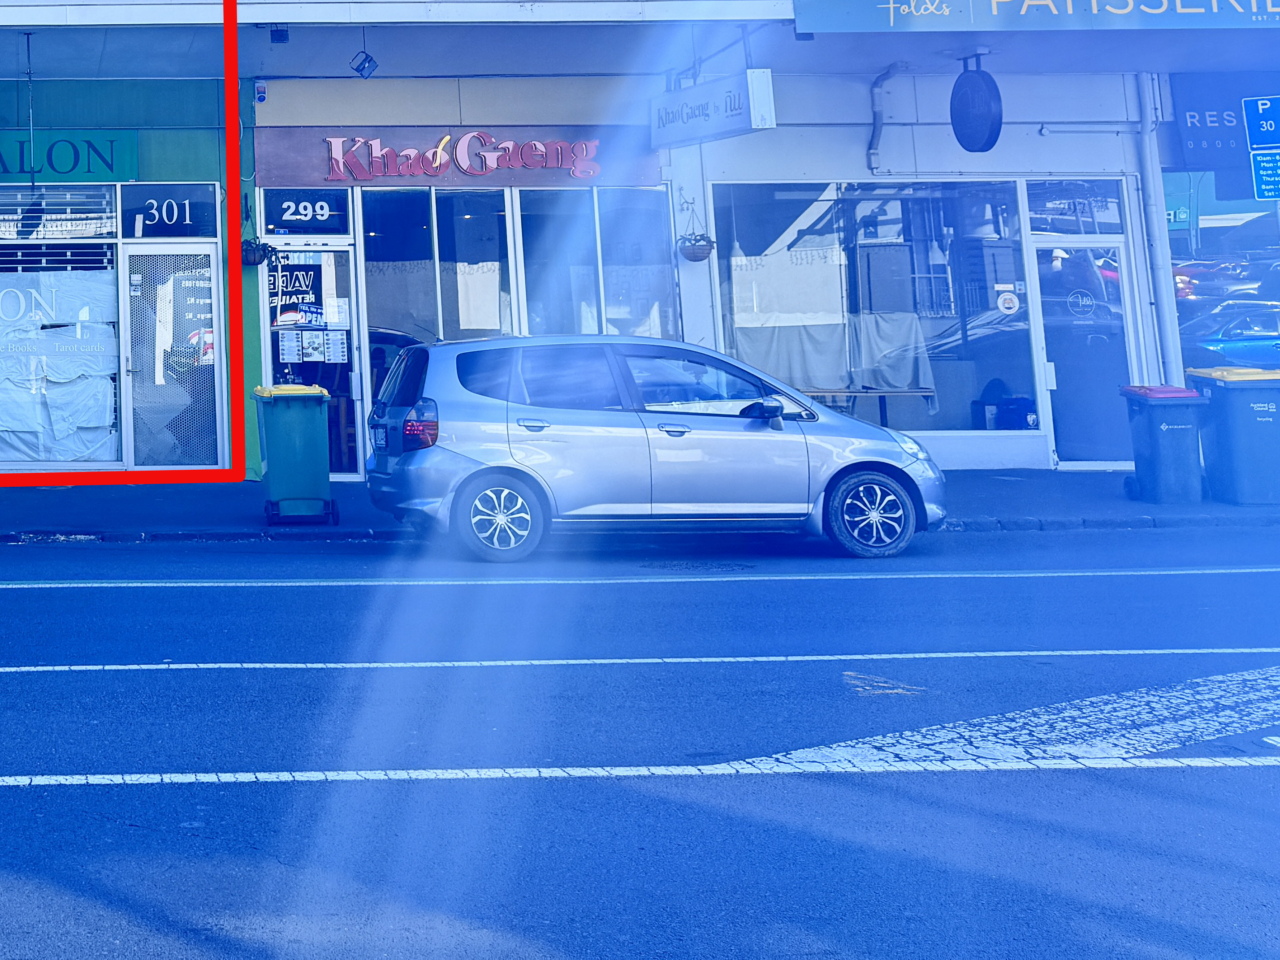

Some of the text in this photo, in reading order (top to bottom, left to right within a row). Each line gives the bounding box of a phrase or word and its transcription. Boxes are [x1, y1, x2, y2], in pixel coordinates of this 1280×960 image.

[680, 101, 710, 125] Gaeng
[1257, 100, 1271, 114] P
[1185, 111, 1237, 127] RES
[1260, 121, 1275, 131] 30
[453, 130, 601, 179] Gaeng
[145, 199, 193, 225] 301
[281, 201, 330, 221] 299
[9, 343, 37, 353] Books
[53, 343, 78, 352] Tarot
[81, 343, 105, 352] cards
